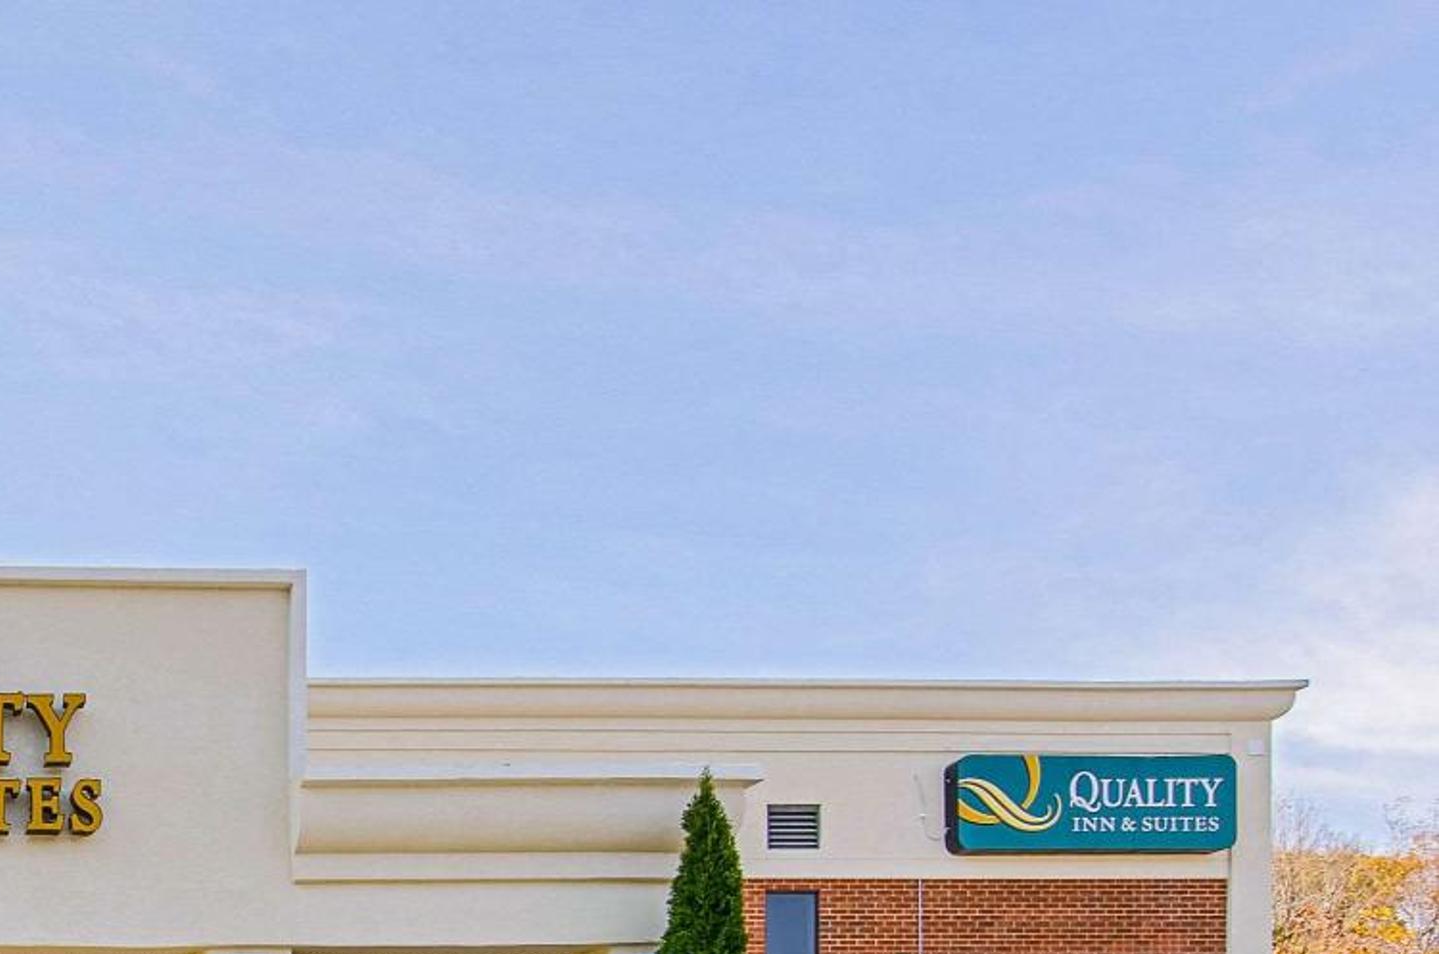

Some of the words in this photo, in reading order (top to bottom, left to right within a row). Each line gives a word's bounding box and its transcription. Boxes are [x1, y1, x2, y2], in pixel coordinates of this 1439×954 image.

[1069, 770, 1224, 813] QUALITY
[1071, 816, 1116, 833] INN
[1120, 816, 1138, 833] &
[1141, 816, 1220, 833] SUITES
